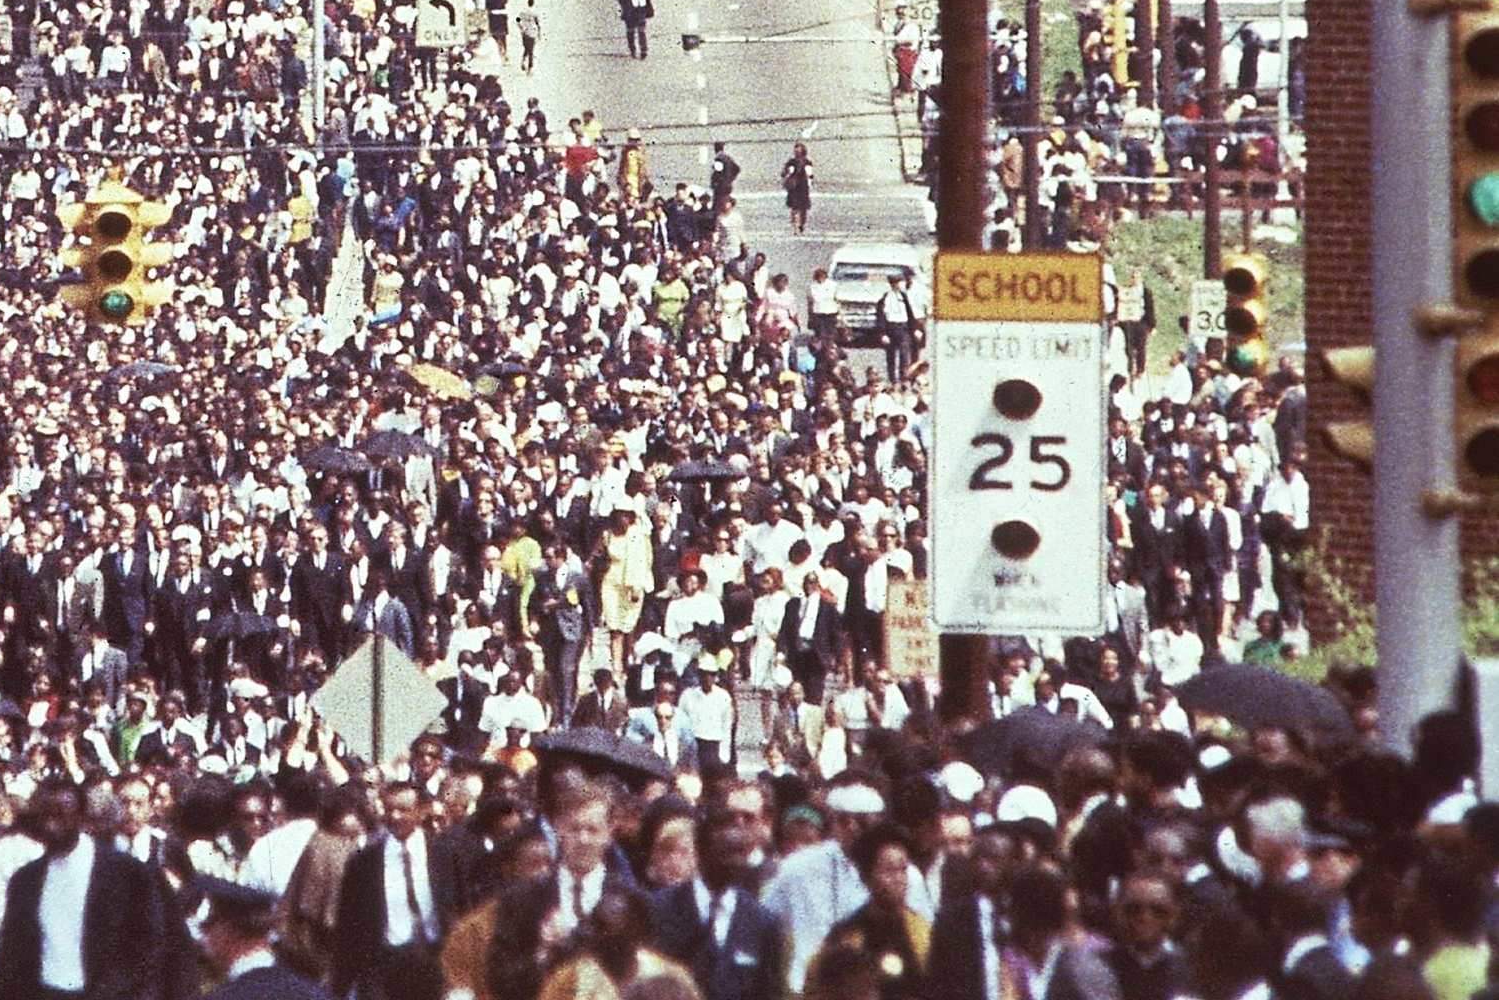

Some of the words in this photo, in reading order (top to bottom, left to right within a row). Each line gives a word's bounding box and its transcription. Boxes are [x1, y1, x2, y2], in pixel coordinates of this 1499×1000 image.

[423, 29, 460, 42] ONLY
[948, 270, 1091, 305] SCHOOL
[945, 335, 1020, 359] SPEED
[1033, 335, 1091, 359] LIMIT
[968, 433, 1072, 492] 25
